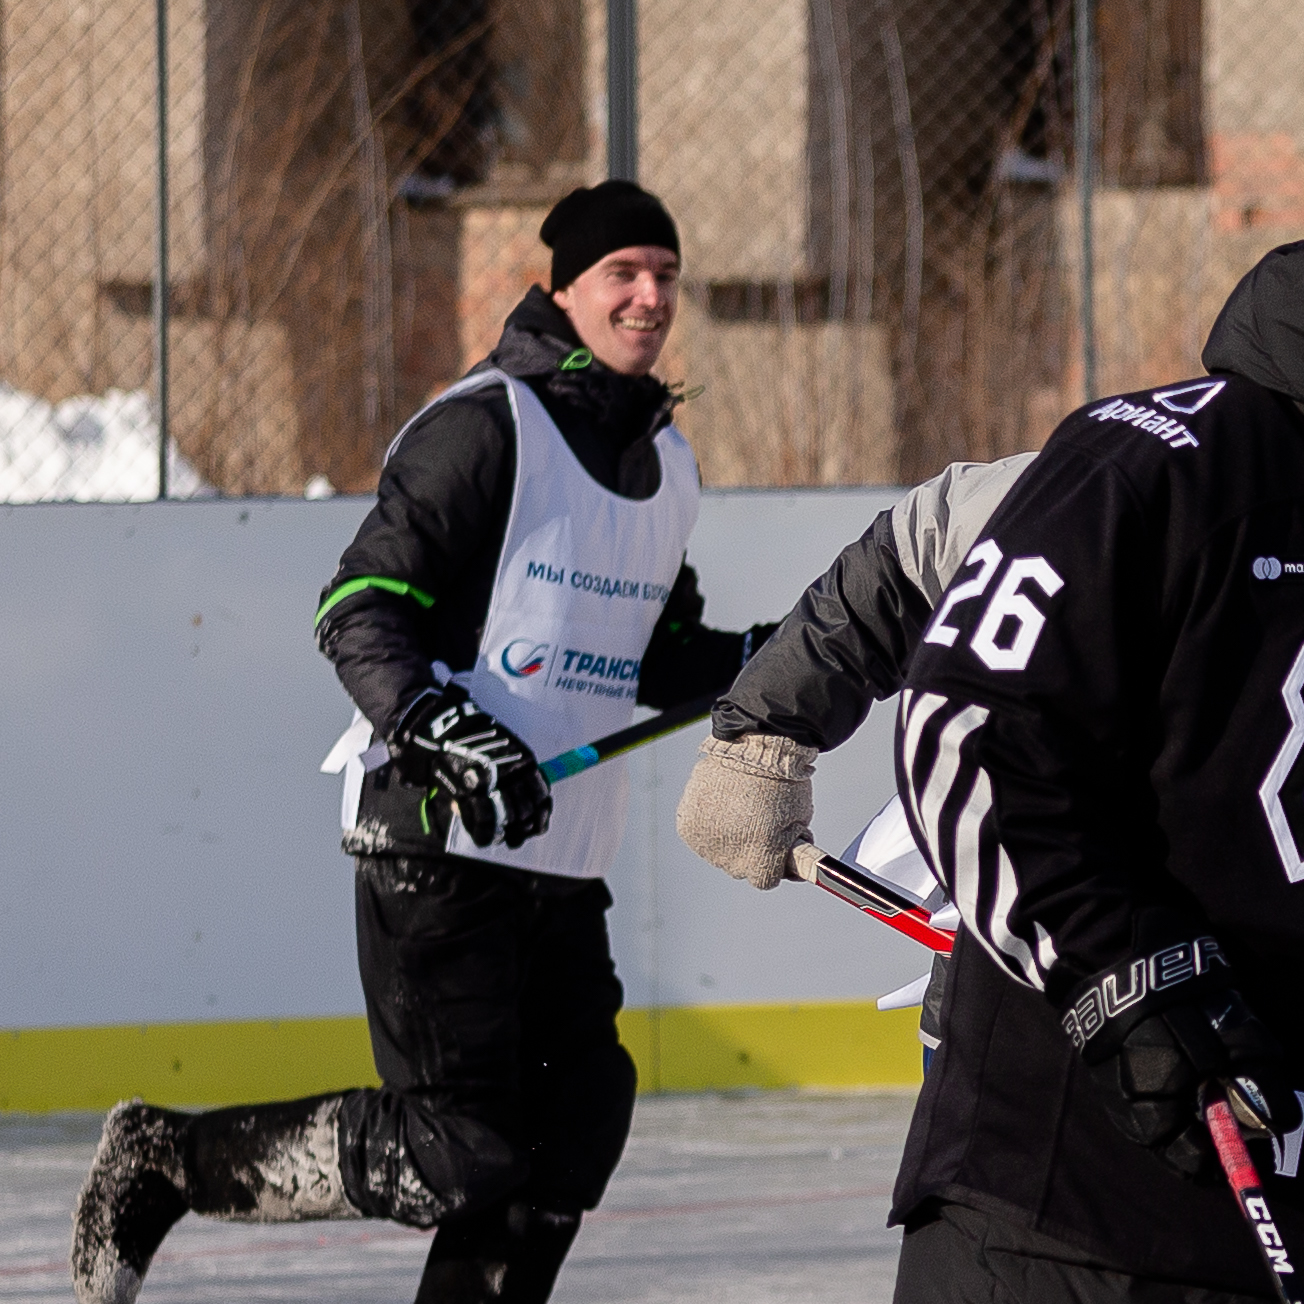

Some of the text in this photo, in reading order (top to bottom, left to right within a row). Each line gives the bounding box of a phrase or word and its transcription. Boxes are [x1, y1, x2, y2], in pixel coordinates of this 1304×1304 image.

[526, 560, 565, 585] МЫ
[570, 571, 640, 598] СОЗДАЕМ
[924, 539, 1065, 671] 26
[1245, 1196, 1294, 1274] CCM
